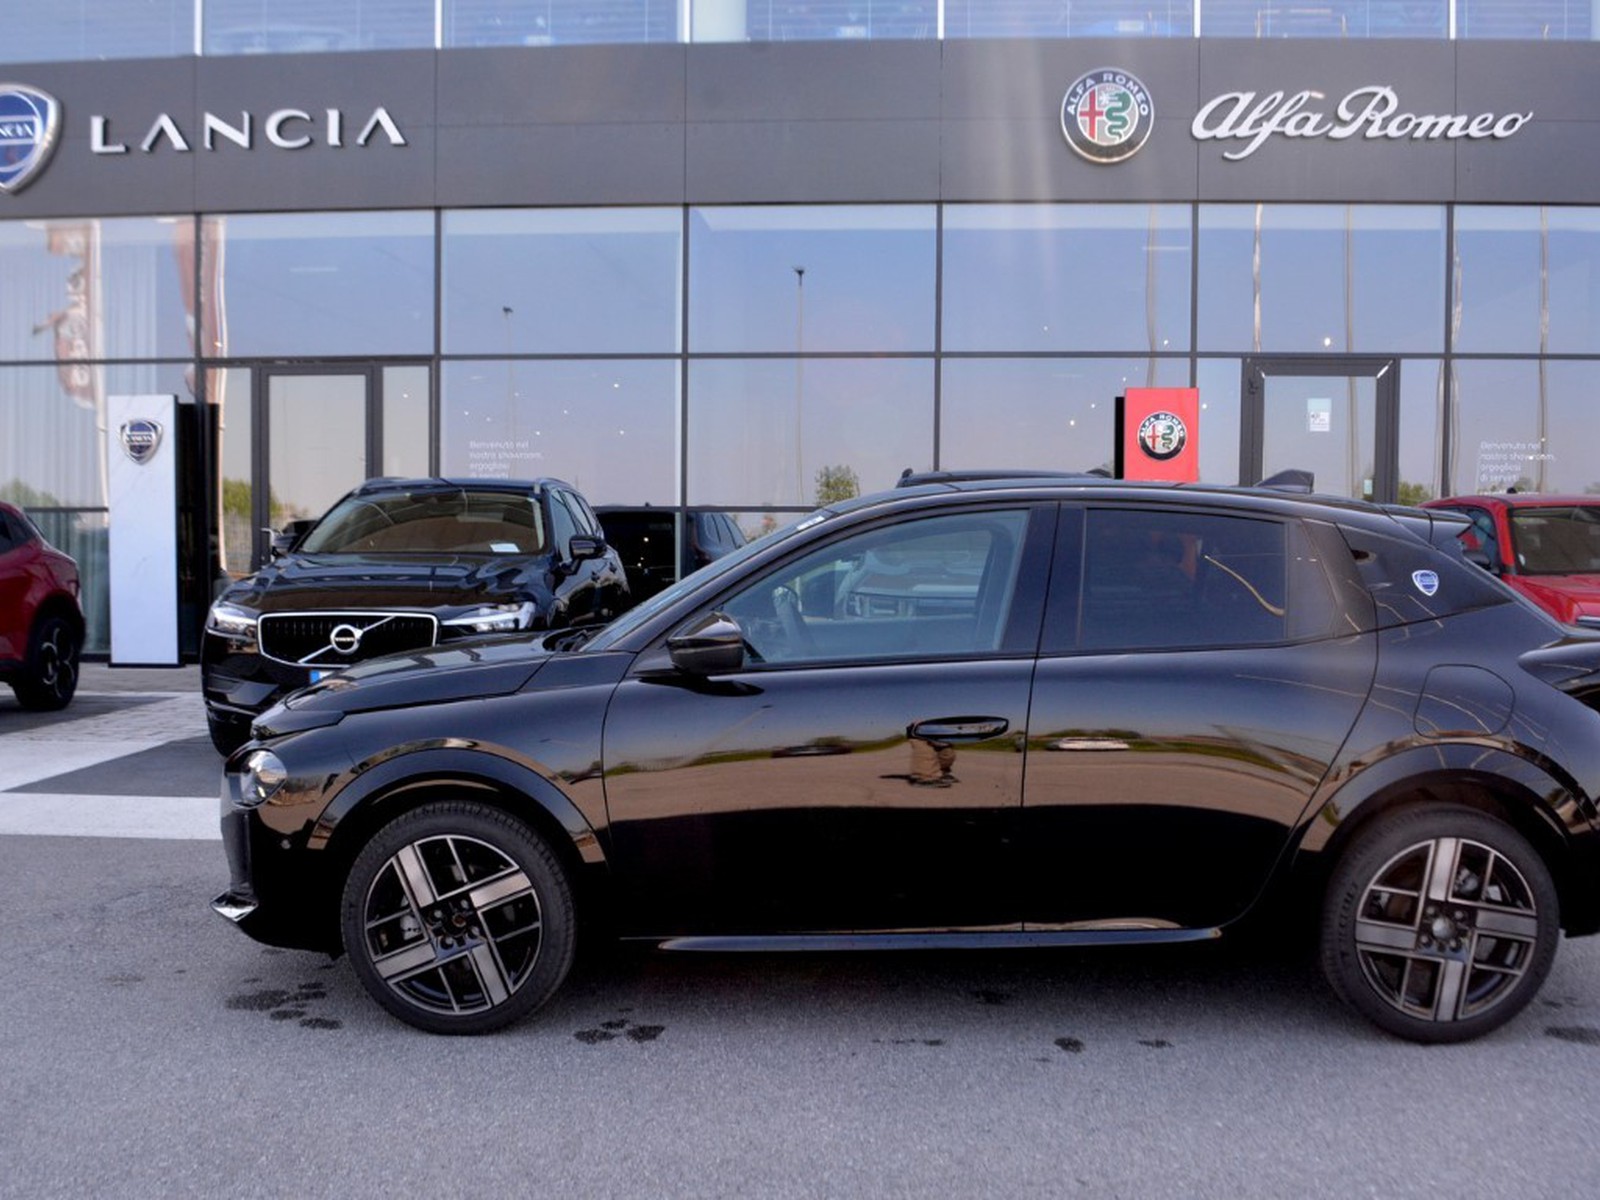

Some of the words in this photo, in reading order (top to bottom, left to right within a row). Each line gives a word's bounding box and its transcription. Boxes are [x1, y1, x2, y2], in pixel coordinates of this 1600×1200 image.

[1067, 78, 1096, 115] ALFA
[1103, 72, 1149, 115] ROMEO
[89, 106, 407, 154] LANCIA
[1191, 90, 1335, 161] Alfa
[1327, 85, 1533, 139] Romeo
